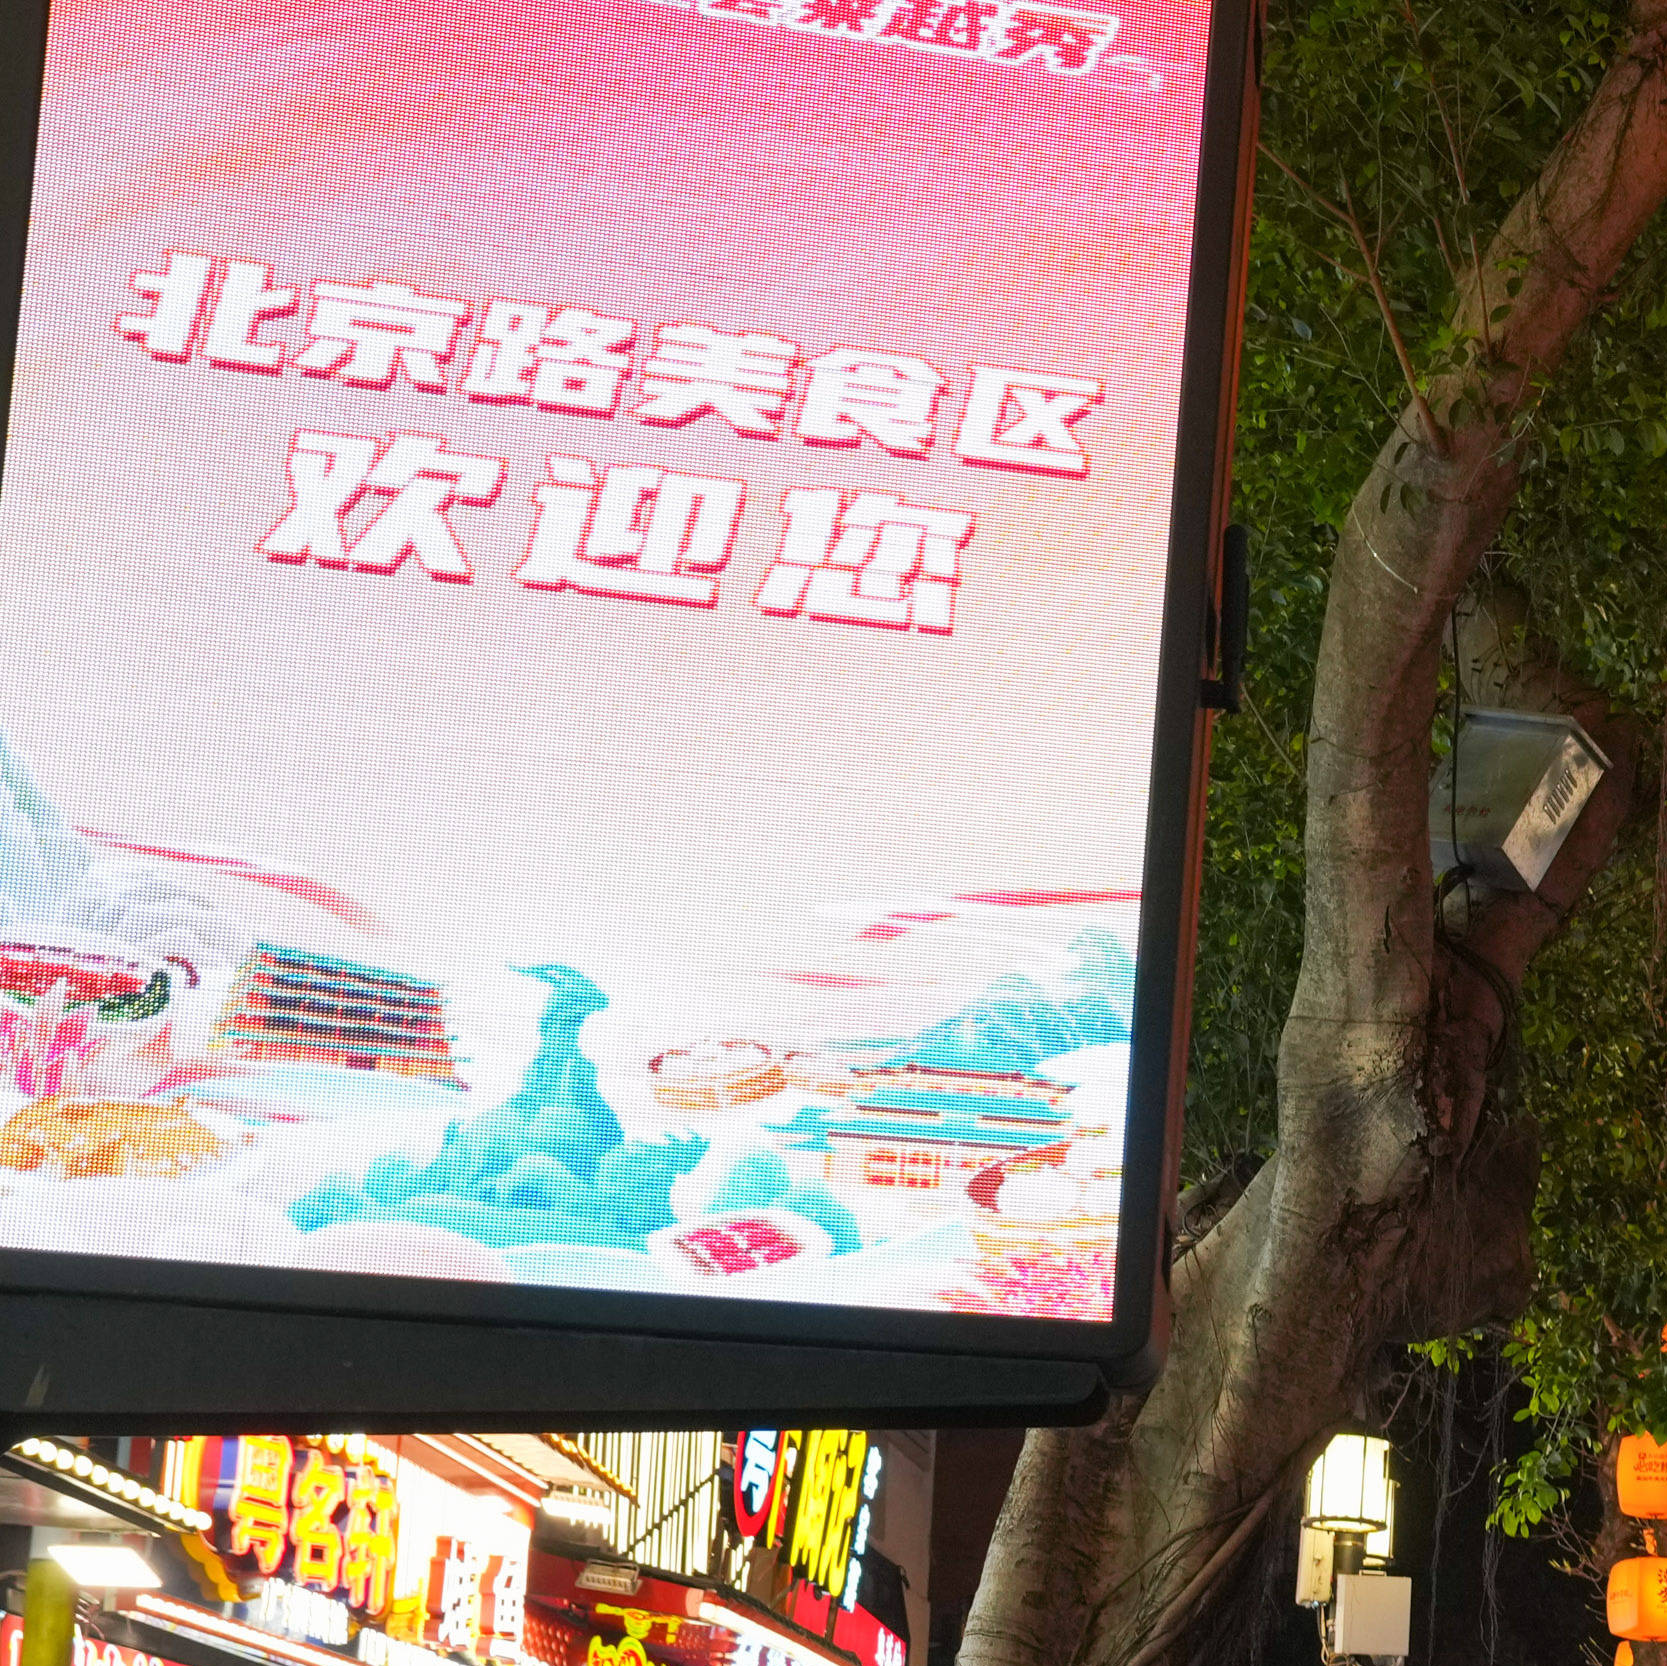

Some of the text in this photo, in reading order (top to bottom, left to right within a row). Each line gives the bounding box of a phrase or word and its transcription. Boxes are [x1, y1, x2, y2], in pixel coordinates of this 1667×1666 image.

[116, 248, 1105, 478] 北京路美食区
[259, 430, 977, 635] 欢迎您
